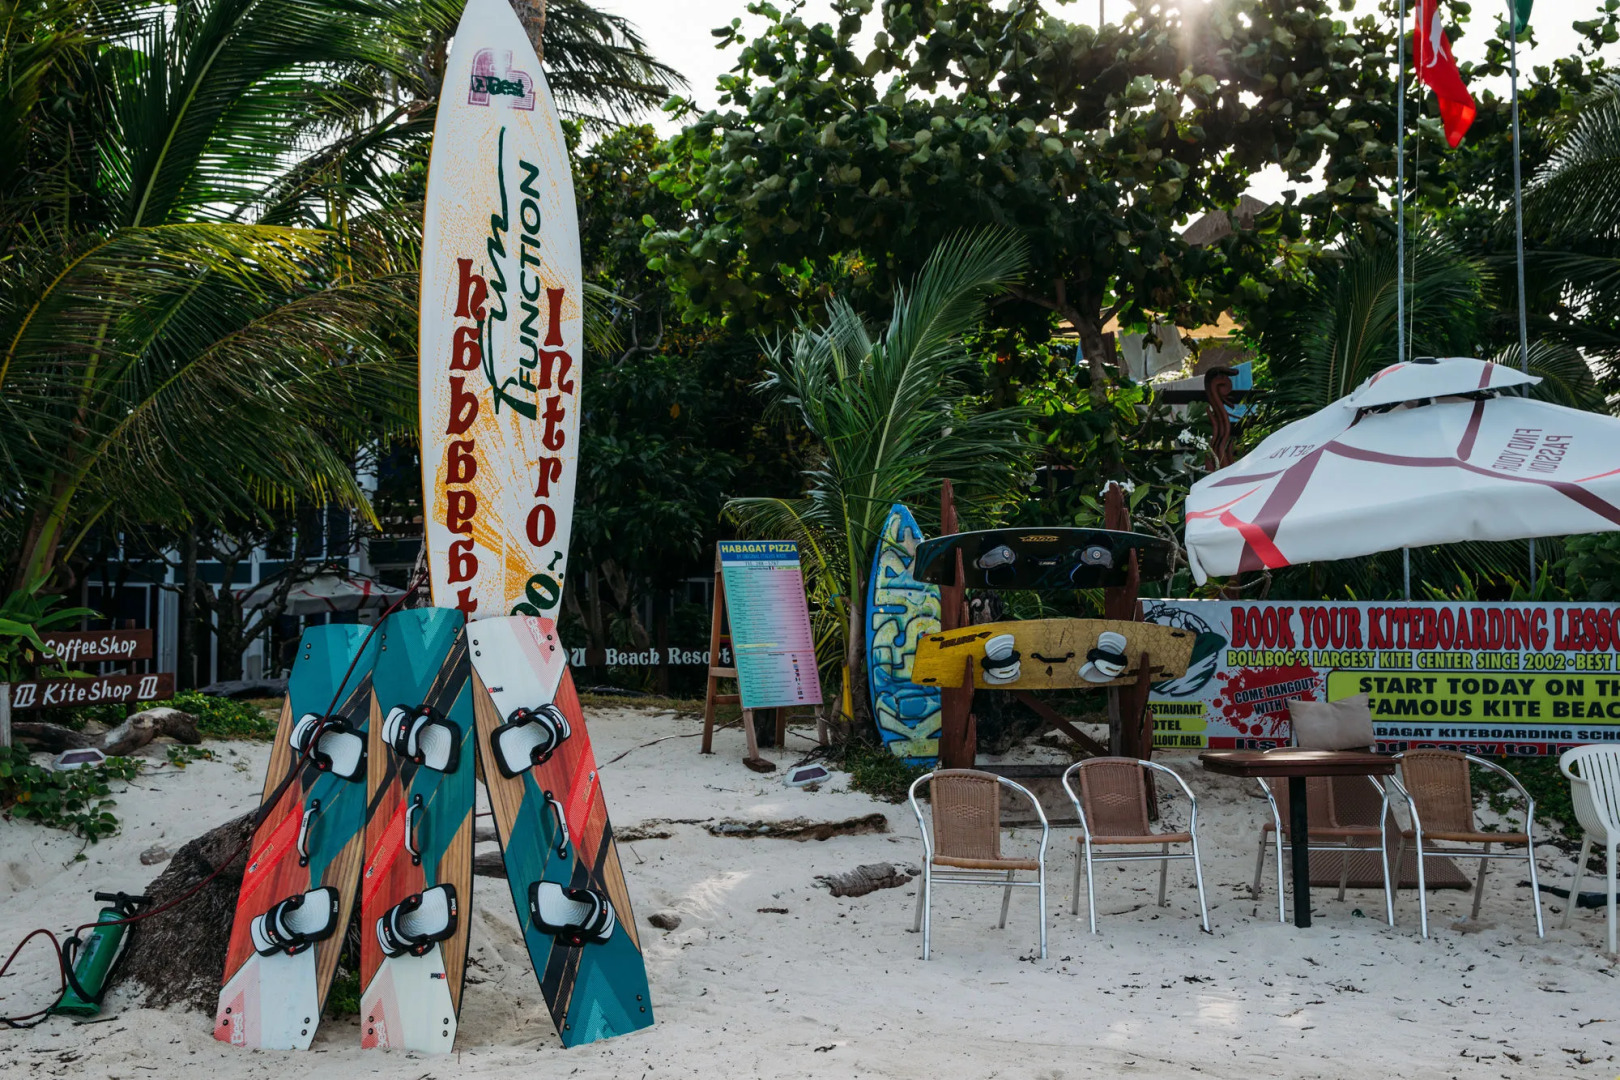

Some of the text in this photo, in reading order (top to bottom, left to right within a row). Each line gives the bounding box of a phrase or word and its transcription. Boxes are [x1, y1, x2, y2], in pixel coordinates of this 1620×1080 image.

[518, 160, 541, 393] FUNCTION
[526, 287, 574, 548] Intro
[721, 544, 798, 554] HABAGAT PIZZA
[525, 617, 546, 645] Best
[1231, 606, 1295, 649] BOOK
[1299, 606, 1363, 649] YOUR
[1367, 607, 1549, 651] KITEBOARDING
[605, 648, 660, 665] Beach
[668, 647, 731, 665] Resot
[1227, 651, 1310, 667] BOLABOG'S
[1313, 651, 1376, 668] LARGEST
[1379, 651, 1412, 669] KITE
[1417, 652, 1473, 669] CENTER
[1476, 652, 1519, 669] SINCE
[42, 683, 86, 705] Kite
[88, 680, 132, 701] Shop
[1234, 678, 1315, 704] COME HANGOUT
[1359, 677, 1437, 694] START
[1447, 678, 1534, 695] TODAY
[1545, 679, 1584, 696] ON
[1253, 699, 1283, 715] WITH
[1483, 700, 1541, 717] KITE
[1180, 735, 1202, 746] AREA
[1438, 728, 1573, 740] KITEBOARDING
[1578, 729, 1620, 740] SCH
[1504, 743, 1539, 756] to
